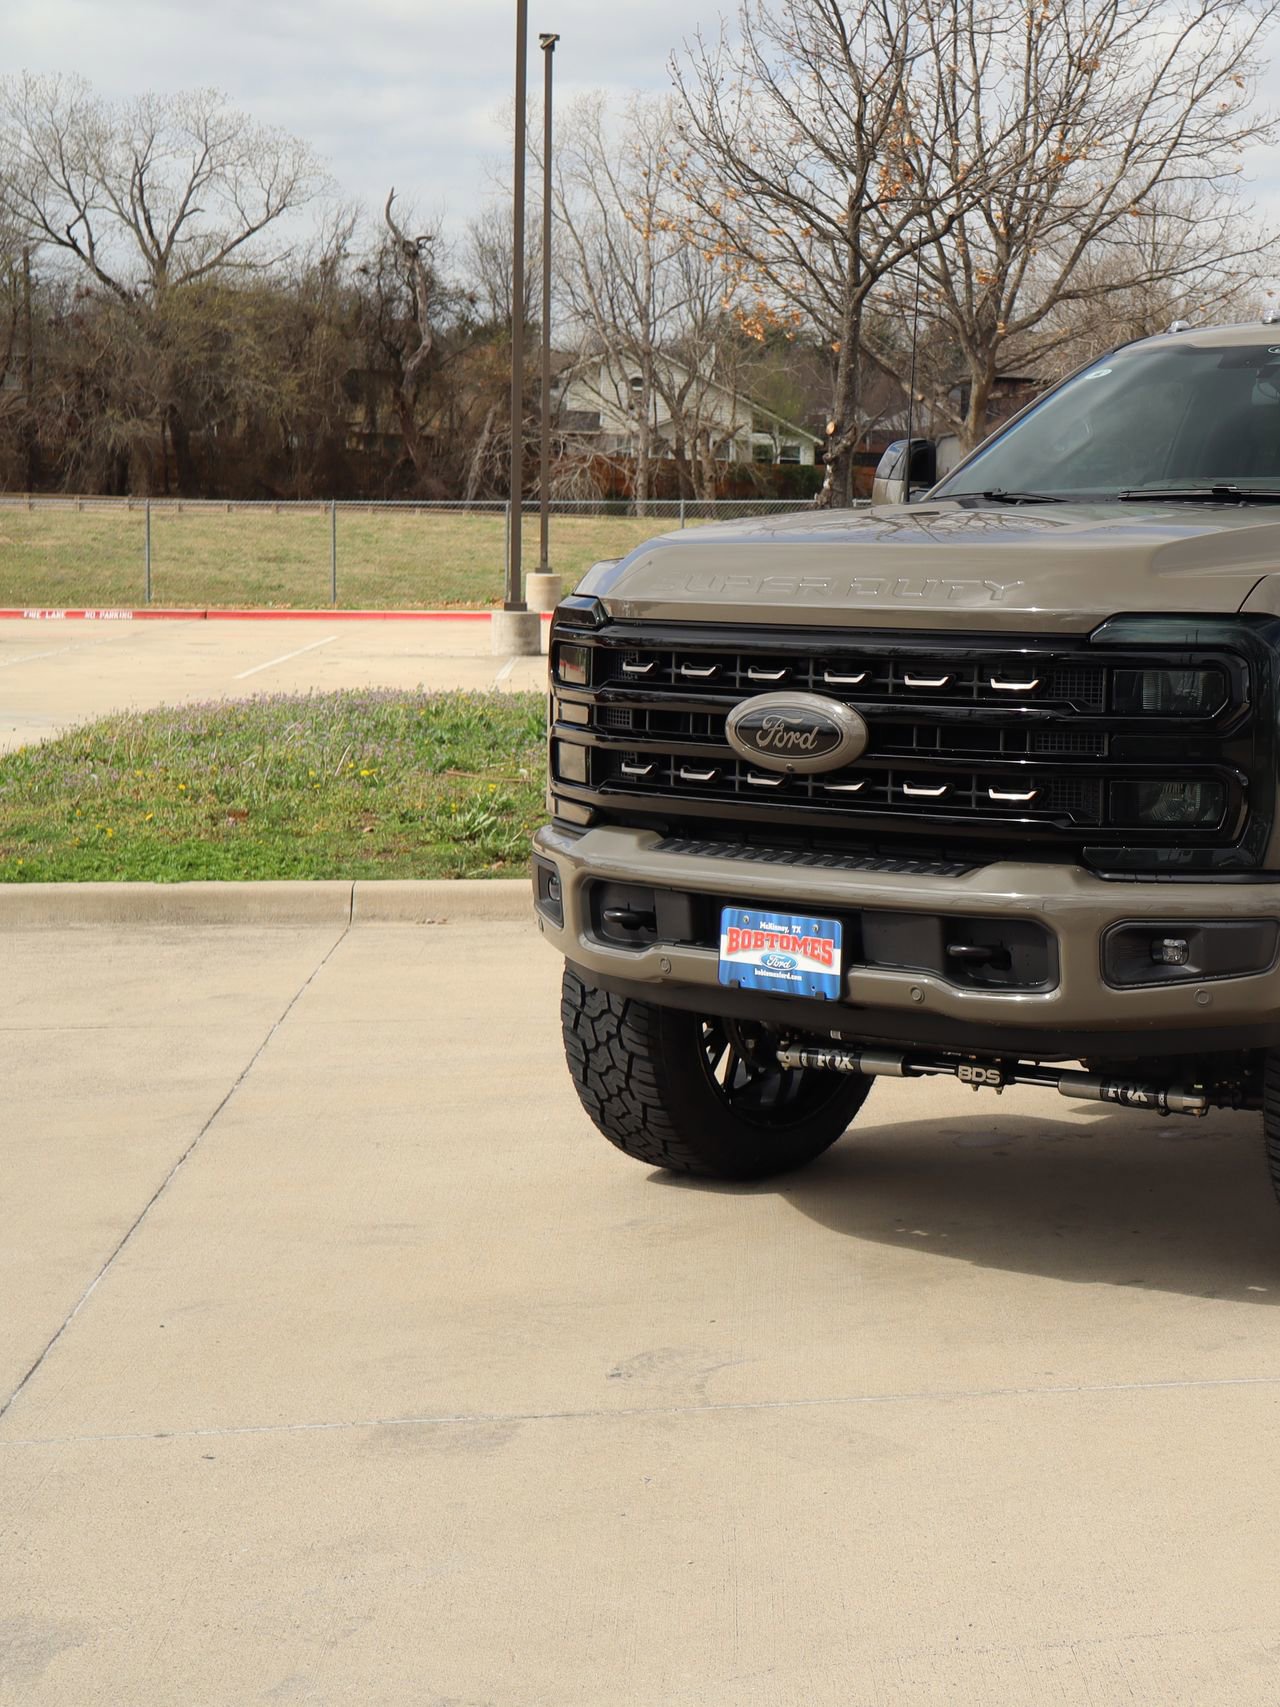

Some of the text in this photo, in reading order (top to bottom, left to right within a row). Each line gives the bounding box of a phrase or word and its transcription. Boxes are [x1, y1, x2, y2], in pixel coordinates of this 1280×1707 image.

[847, 577, 1025, 601] DUTY
[84, 610, 96, 619] NO
[99, 610, 133, 619] PARKING
[756, 714, 820, 750] Ford
[791, 925, 802, 933] TX
[727, 927, 834, 967] BOBTOMES
[766, 954, 792, 969] Ford
[817, 1049, 854, 1070] FOX
[958, 1065, 1000, 1084] BDS
